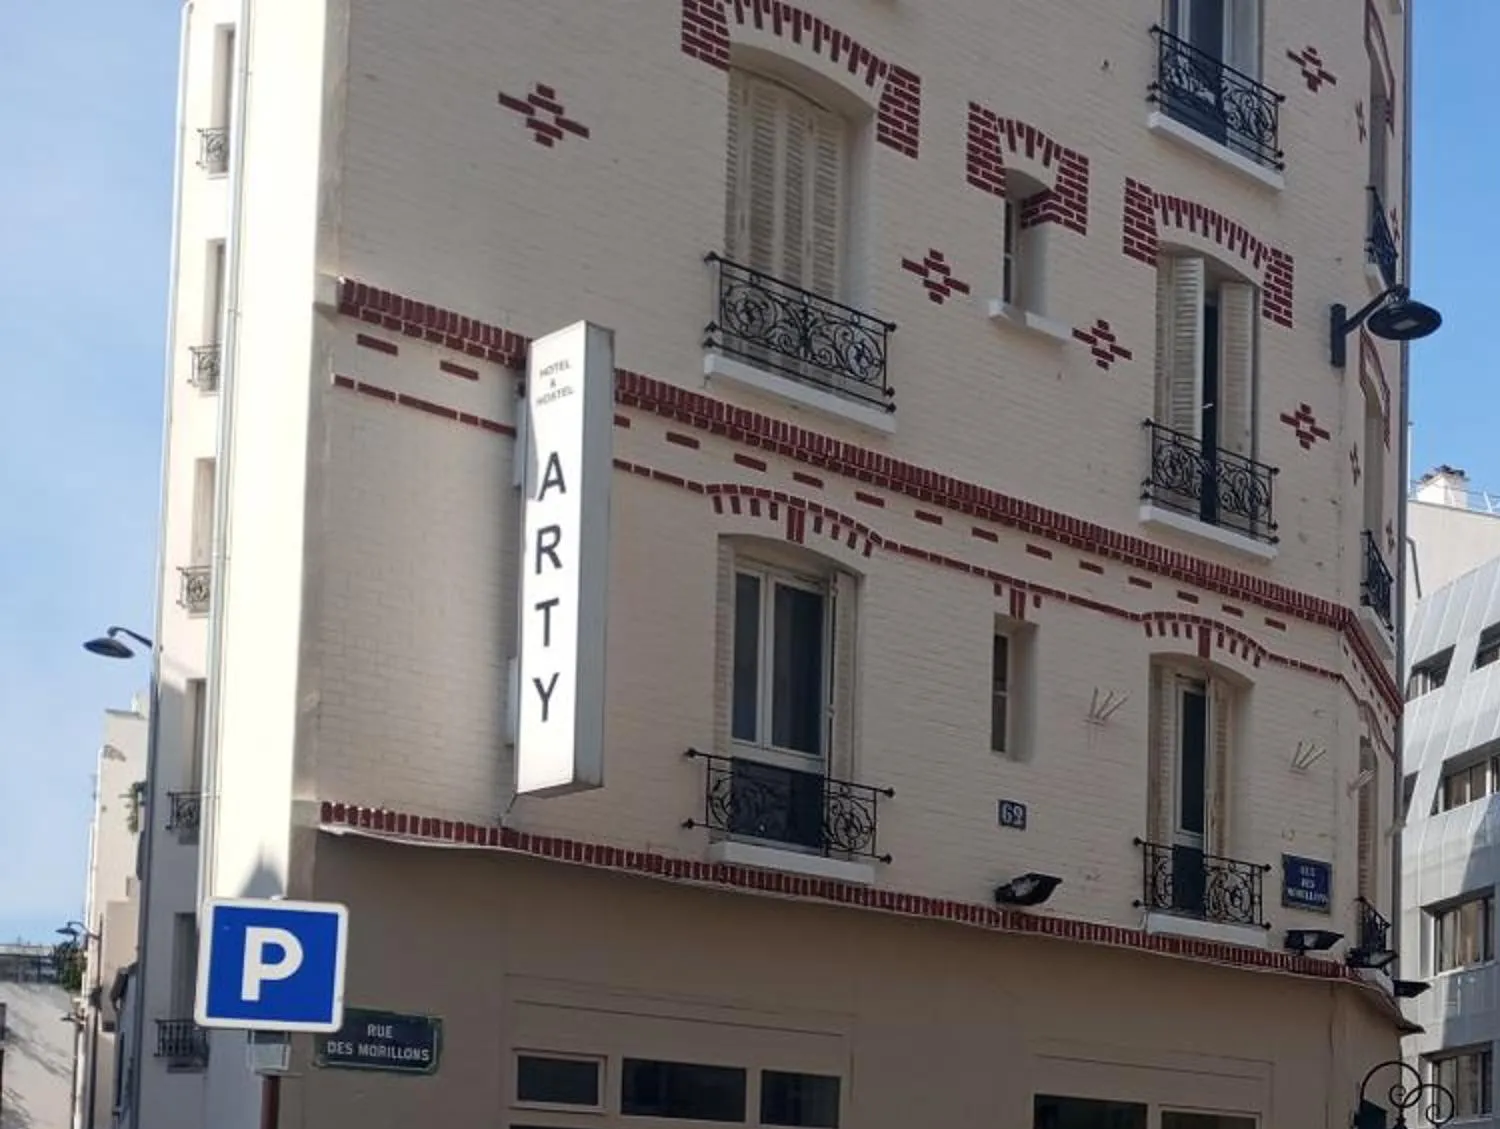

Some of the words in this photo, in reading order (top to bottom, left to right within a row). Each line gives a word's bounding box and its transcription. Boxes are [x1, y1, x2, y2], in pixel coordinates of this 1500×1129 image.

[532, 451, 567, 723] ARTY
[241, 925, 304, 1001] P
[327, 1041, 353, 1056] DES
[358, 1043, 430, 1062] MORILLONS
[367, 1023, 393, 1038] RUE
